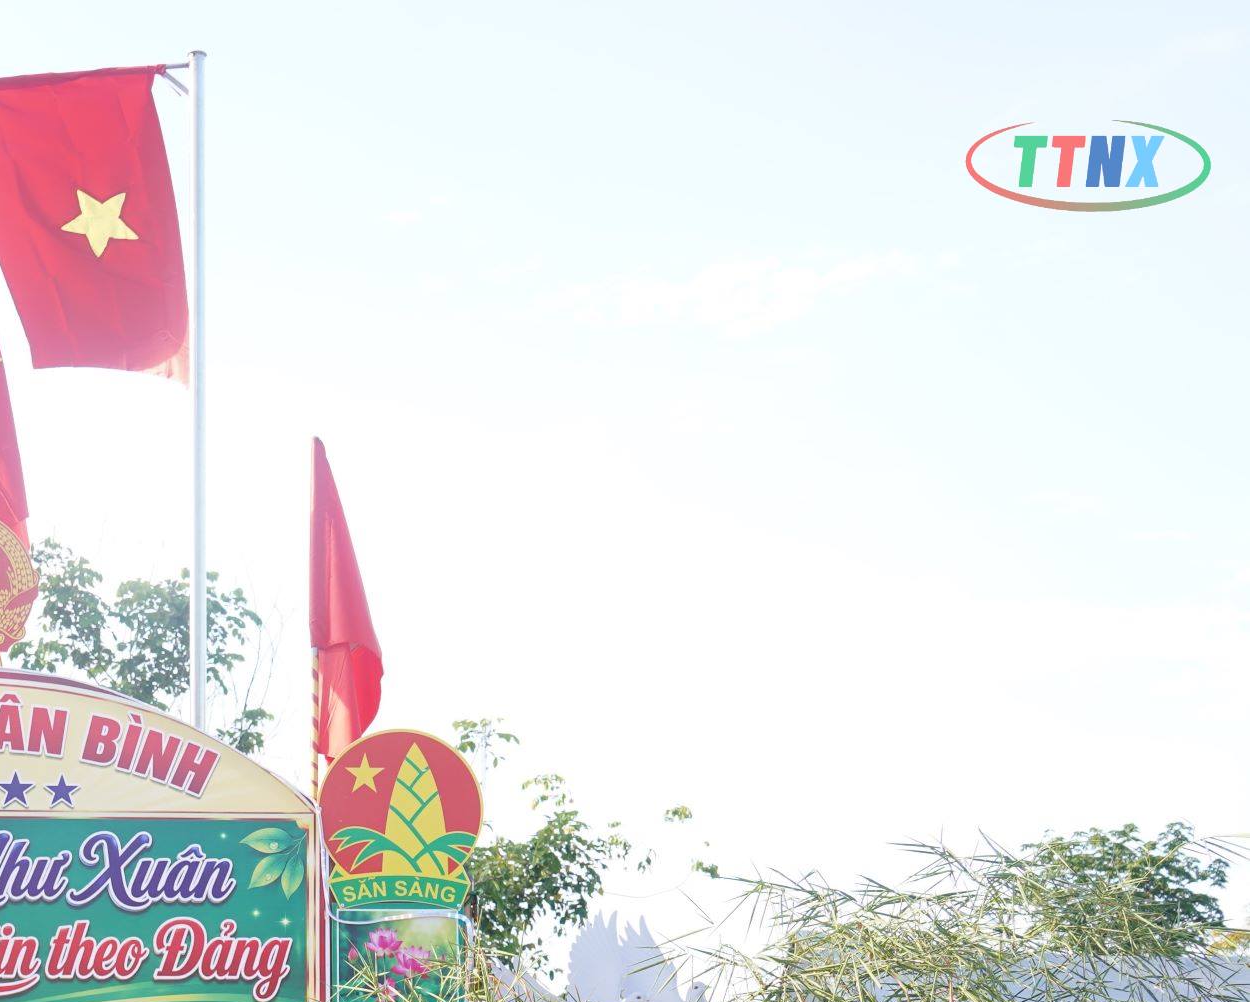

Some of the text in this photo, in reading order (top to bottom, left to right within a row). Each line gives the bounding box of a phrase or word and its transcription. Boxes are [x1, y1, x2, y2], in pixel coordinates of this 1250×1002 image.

[80, 712, 220, 798] BÌNH
[67, 831, 236, 911] Xuân
[342, 877, 457, 903] SẴN SÀNG
[45, 920, 150, 981] theo
[153, 917, 293, 1002] Đảng
